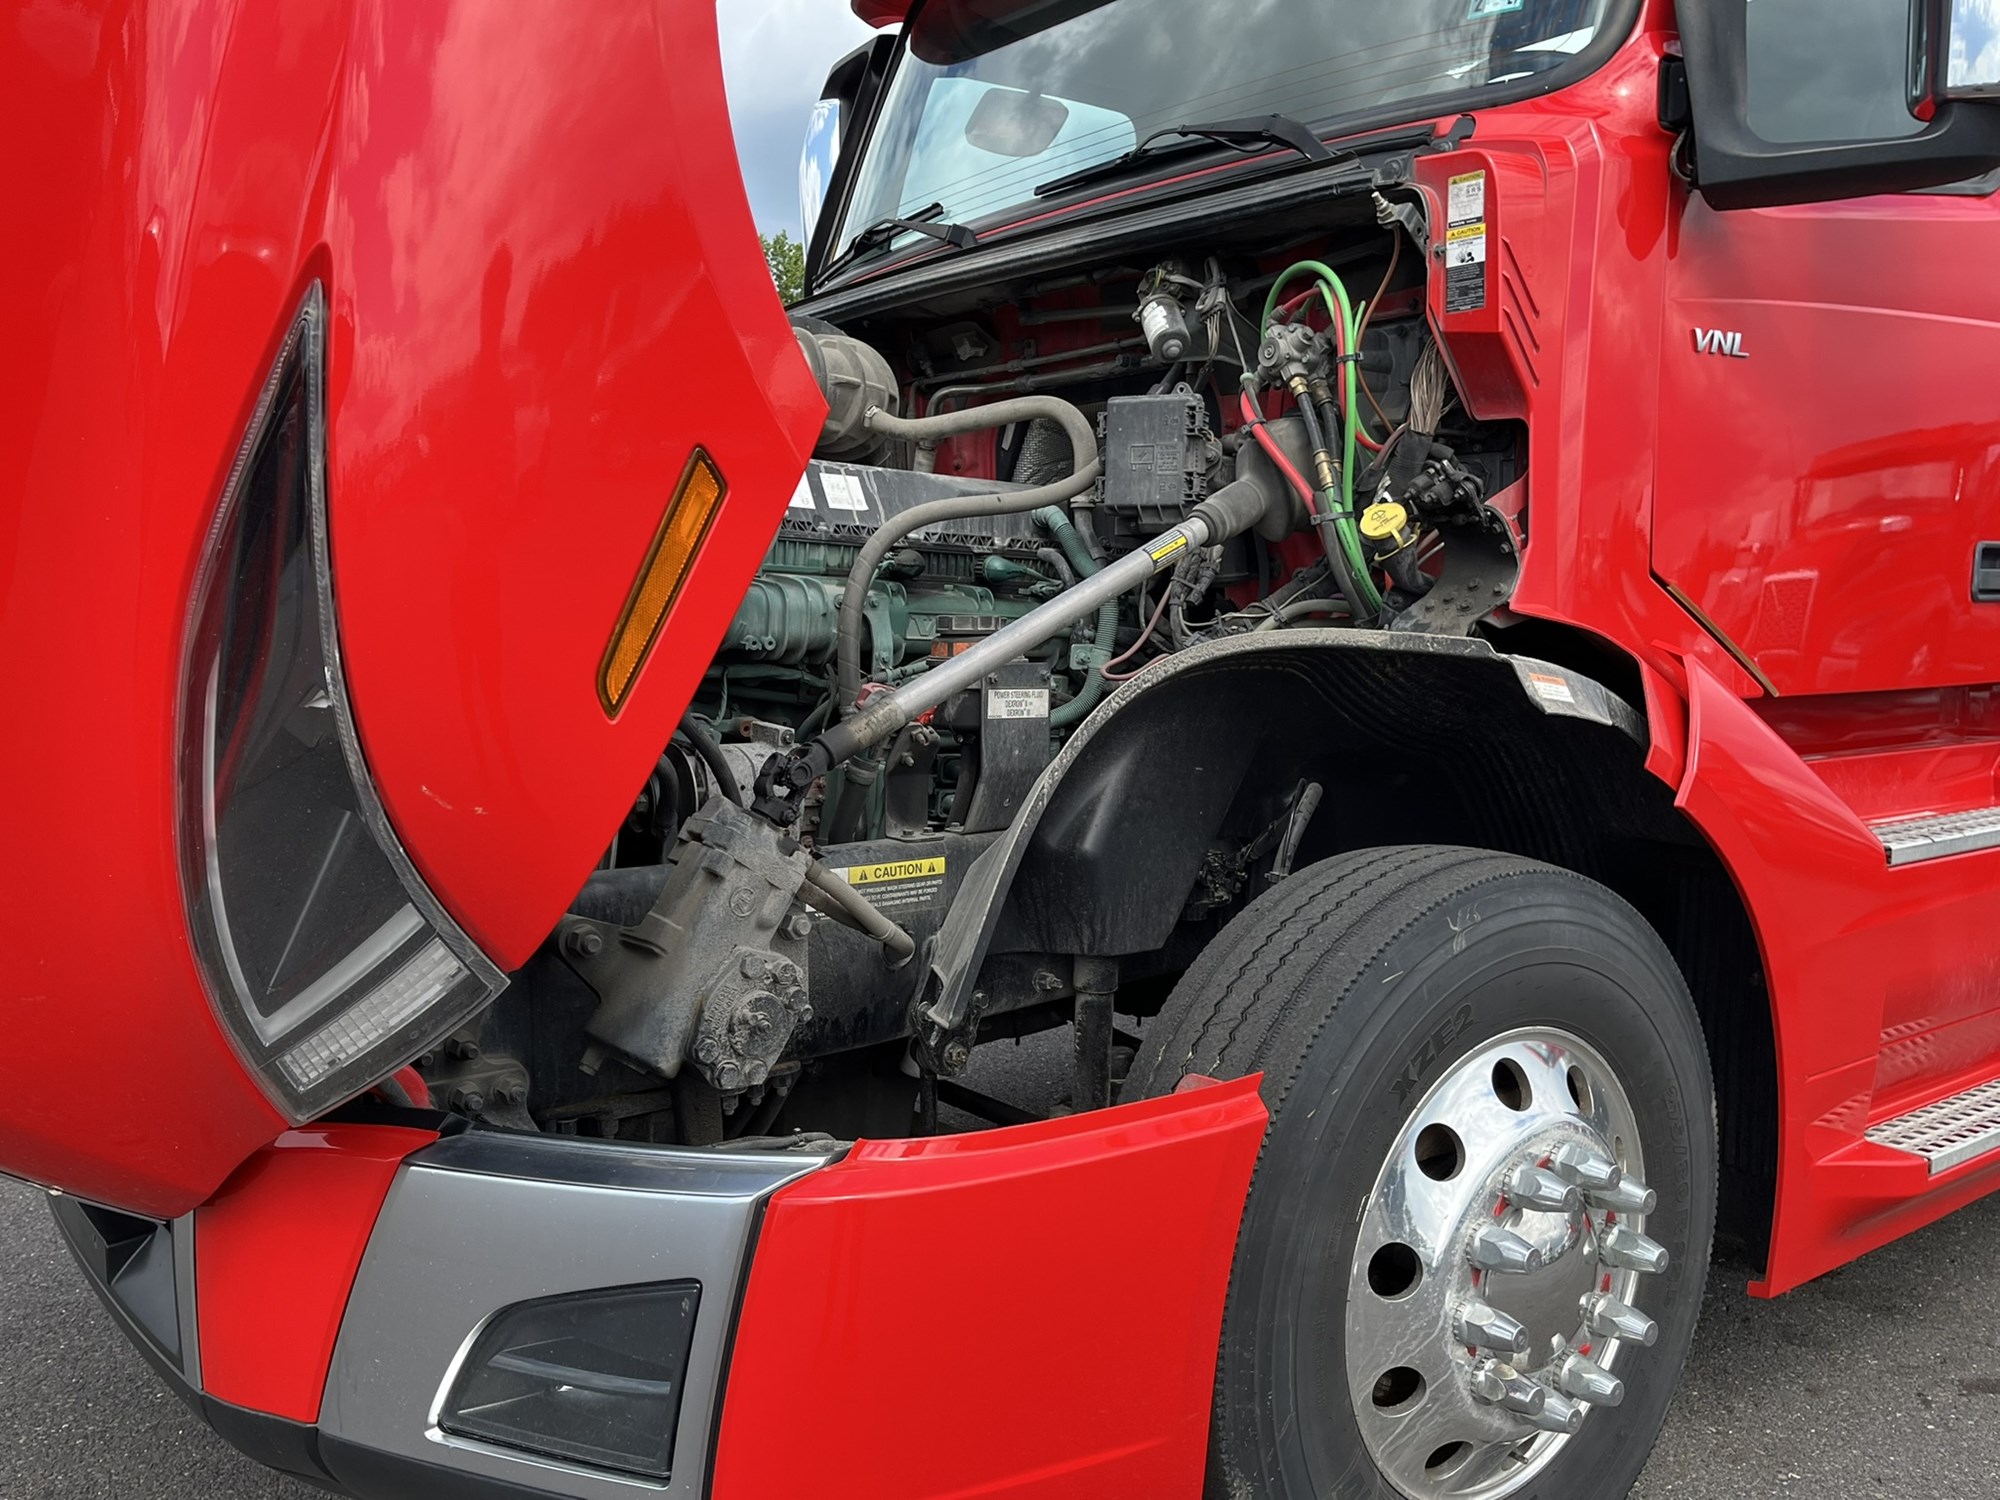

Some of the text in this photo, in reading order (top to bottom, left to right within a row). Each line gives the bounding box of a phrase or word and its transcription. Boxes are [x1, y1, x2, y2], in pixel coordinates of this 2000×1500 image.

[1456, 226, 1481, 235] CAUTION
[1694, 327, 1750, 357] VNL
[994, 691, 1043, 699] POWER STEERING FLUID
[874, 863, 923, 879] CAUTION
[898, 882, 916, 890] STEERING
[1388, 1003, 1475, 1105] XZE2
